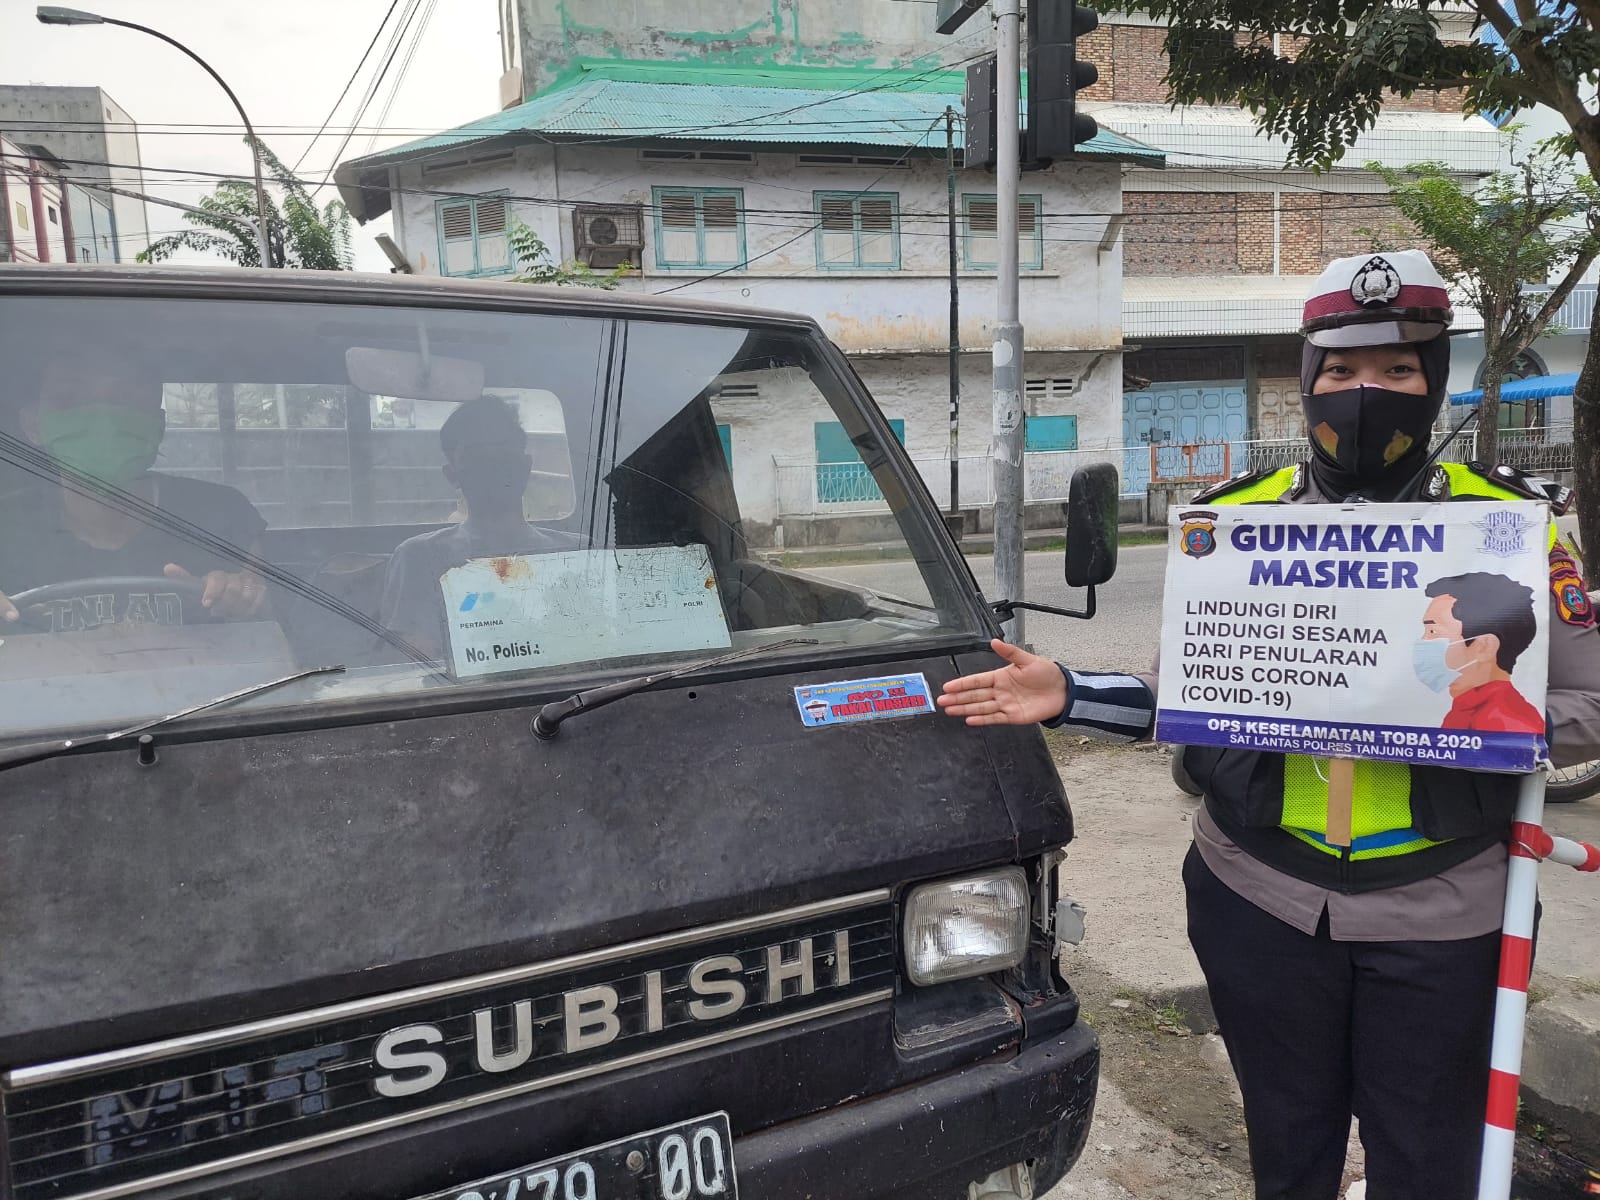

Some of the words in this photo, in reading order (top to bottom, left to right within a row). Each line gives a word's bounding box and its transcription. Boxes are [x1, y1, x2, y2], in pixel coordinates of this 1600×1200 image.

[1231, 524, 1445, 553] GUNAKAN
[1249, 560, 1419, 589] MASKER
[1186, 600, 1286, 618] LINDUNGI
[1293, 603, 1337, 620] DIRI
[459, 619, 504, 629] PERTAMINA
[1184, 621, 1285, 639] LINDUNGI
[1292, 625, 1388, 644] SESAMA
[465, 647, 490, 663] No.
[1183, 642, 1232, 659] DARI
[1239, 645, 1378, 666] PENULARAN
[1182, 663, 1244, 682] VIRUS
[1251, 667, 1349, 688] CORONA
[831, 701, 873, 717] PAKAI
[873, 695, 927, 713] MASKER
[1181, 685, 1292, 711] (COVID-19)
[1207, 718, 1241, 733] OPS
[1245, 721, 1375, 743] KESELAMATAN
[1380, 731, 1432, 747] TOBA
[1437, 734, 1482, 750] 2020
[1230, 733, 1251, 745] SAT
[1254, 736, 1300, 749] LANTAS
[1303, 740, 1352, 753] POLRES
[1355, 743, 1414, 757] TANJUNG
[1417, 748, 1456, 760] BALAI
